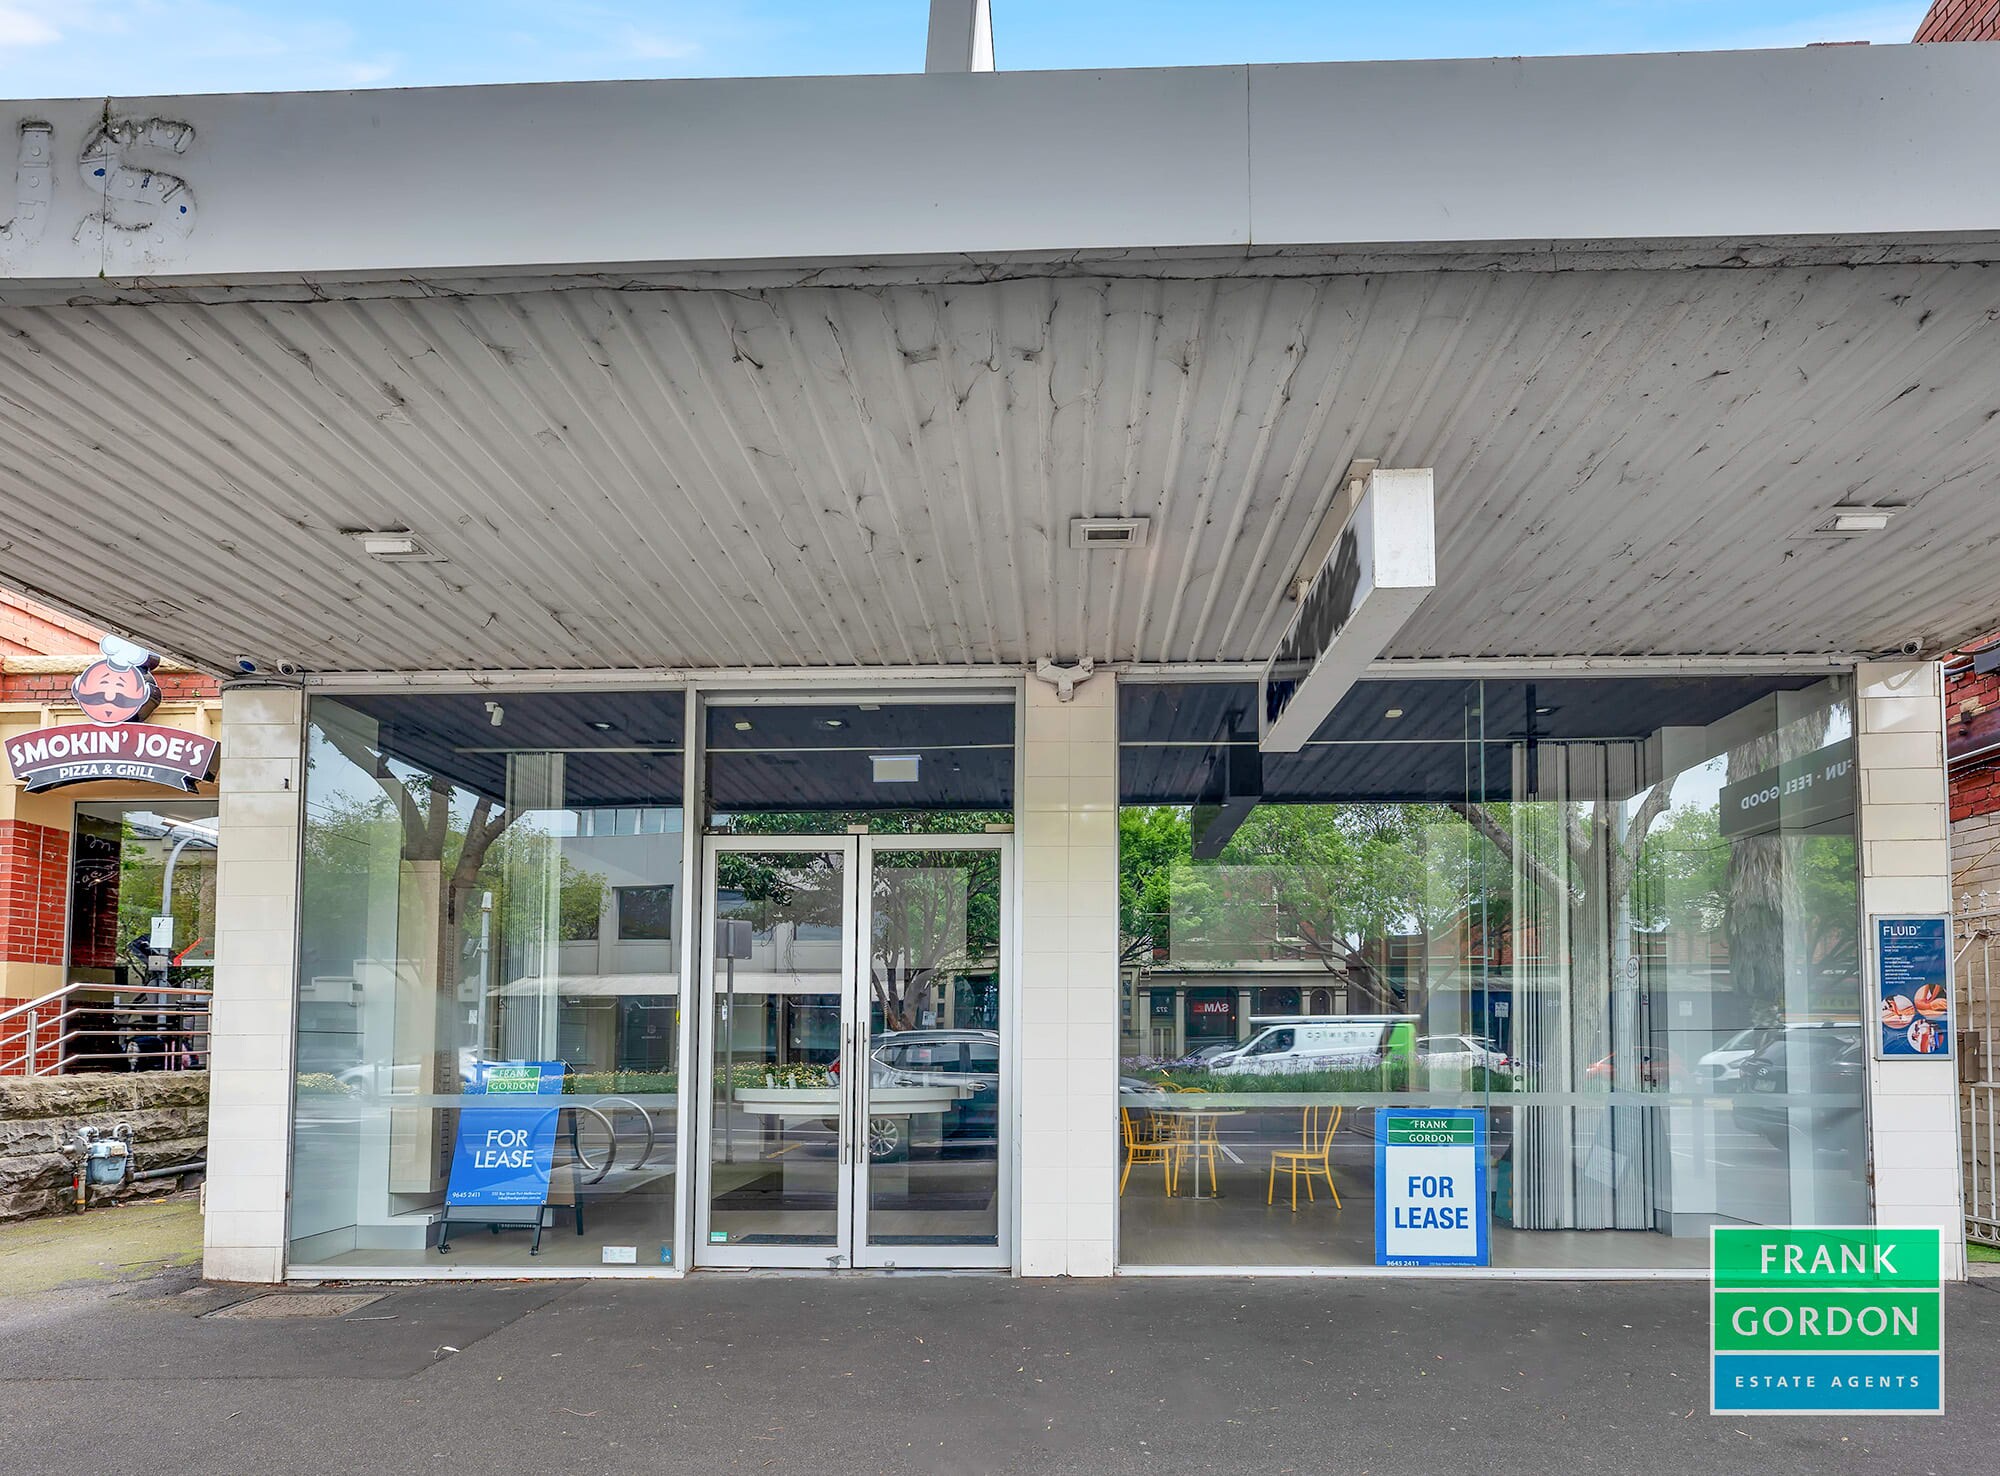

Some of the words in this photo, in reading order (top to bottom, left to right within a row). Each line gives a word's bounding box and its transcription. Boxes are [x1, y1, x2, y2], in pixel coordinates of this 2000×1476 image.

[11, 730, 128, 768] SMOKIN'
[134, 732, 205, 766] JOE'S
[59, 764, 99, 779] PIZZA
[102, 764, 112, 775] &
[116, 764, 155, 779] GRILL
[499, 1069, 530, 1077] FRANK
[491, 1082, 536, 1091] GORDON
[1414, 1120, 1448, 1129] FRANK
[486, 1129, 529, 1148] FOR
[1408, 1134, 1454, 1143] GORDON
[474, 1150, 535, 1169] LEASE
[1408, 1175, 1454, 1198] FOR
[1394, 1206, 1469, 1230] LEASE
